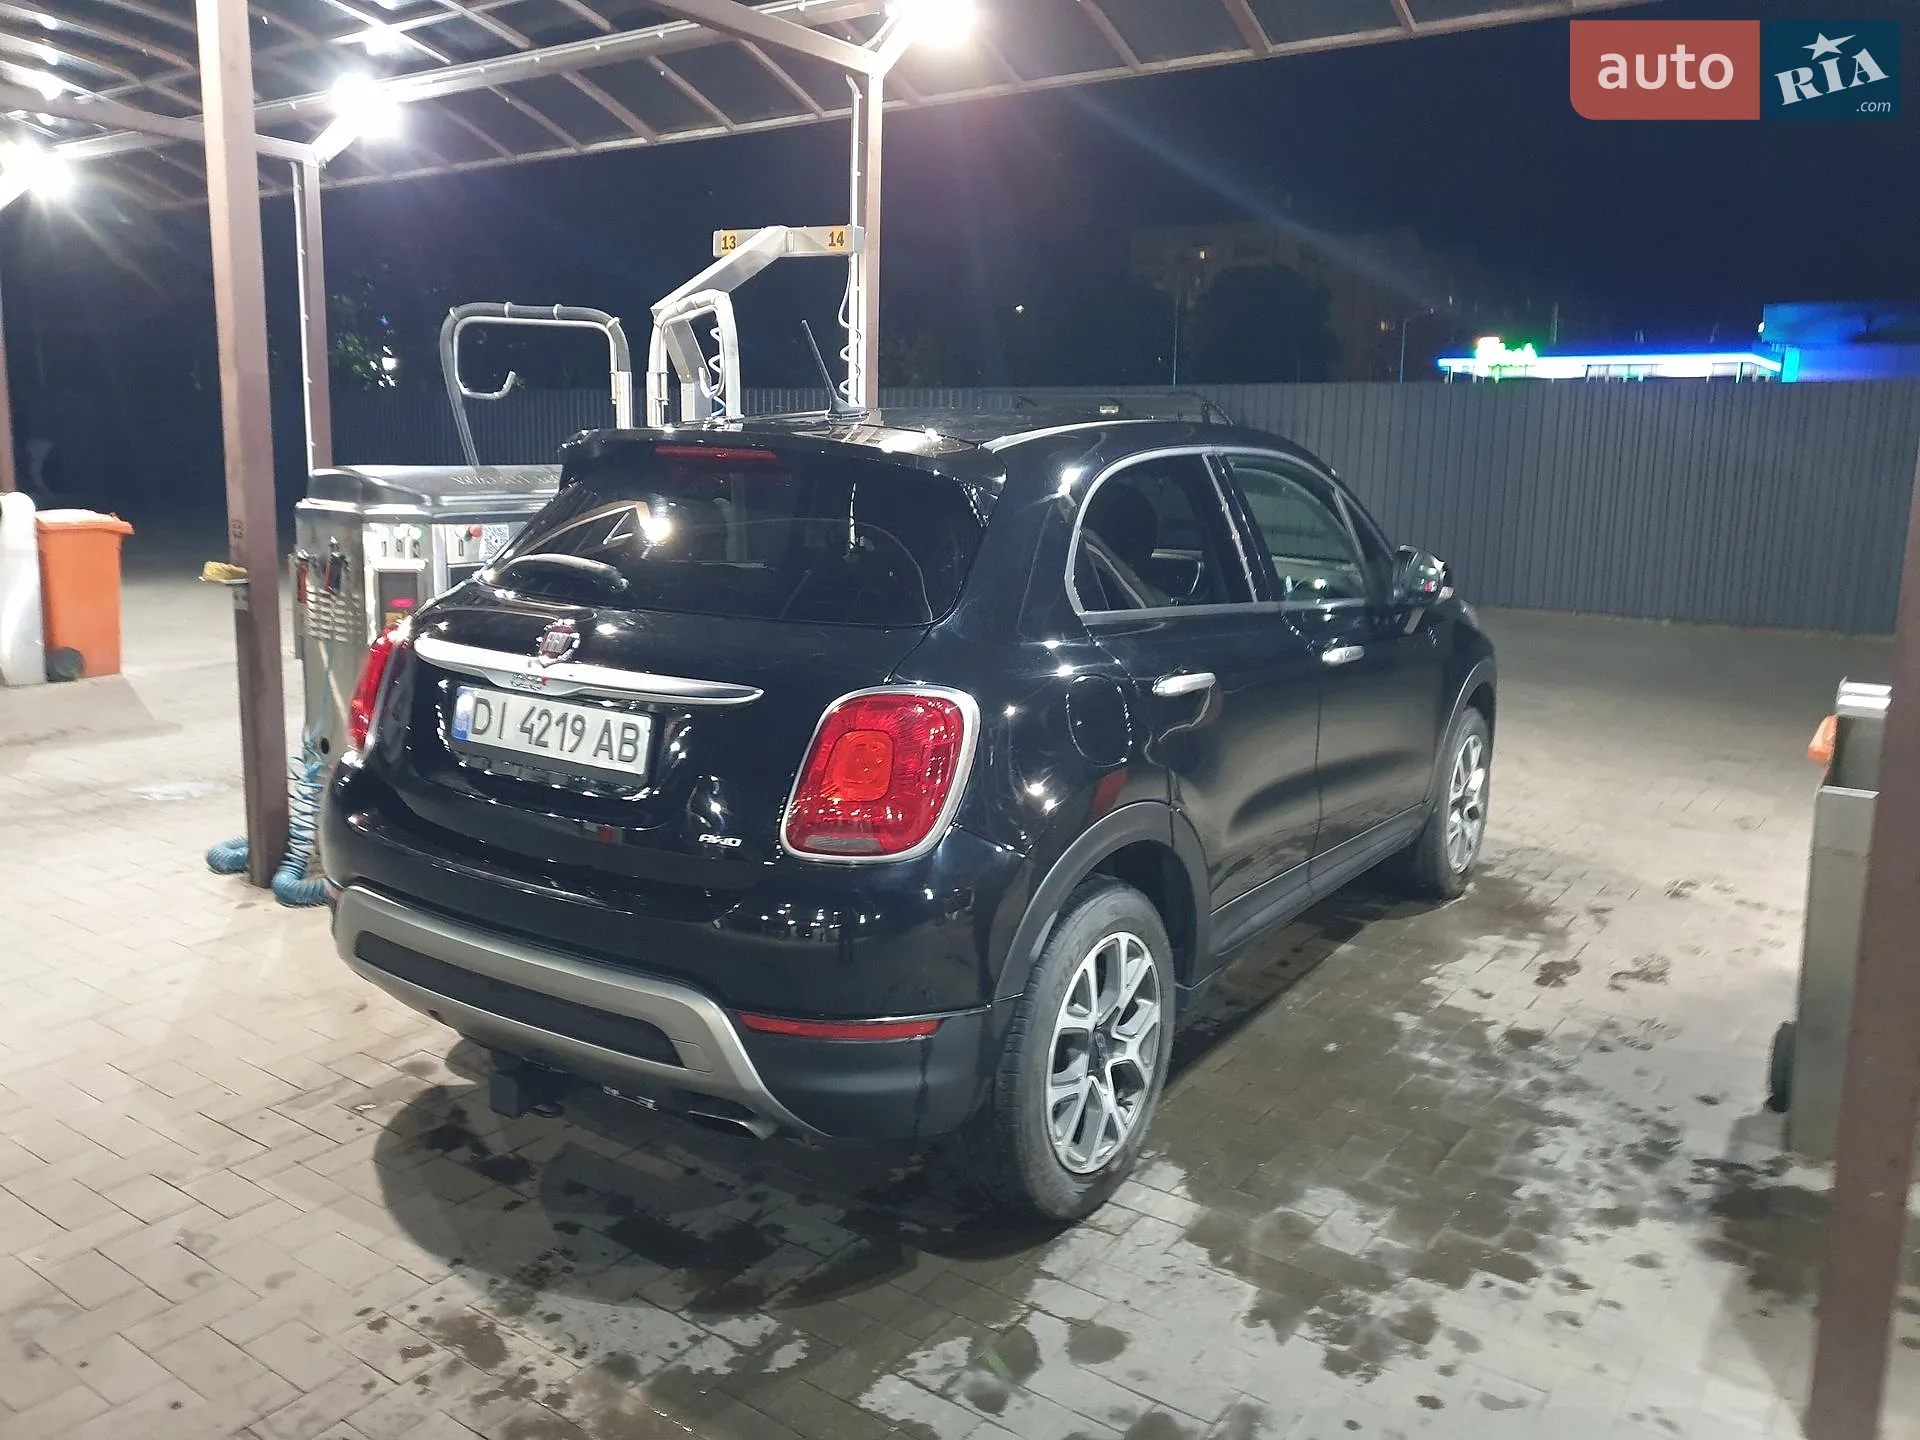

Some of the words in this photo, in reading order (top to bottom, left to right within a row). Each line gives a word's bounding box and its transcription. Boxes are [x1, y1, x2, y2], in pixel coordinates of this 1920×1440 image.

[721, 235, 737, 250] 13
[828, 231, 845, 247] 14
[471, 697, 507, 740] DI
[519, 706, 587, 753] 4219
[592, 719, 641, 763] AB
